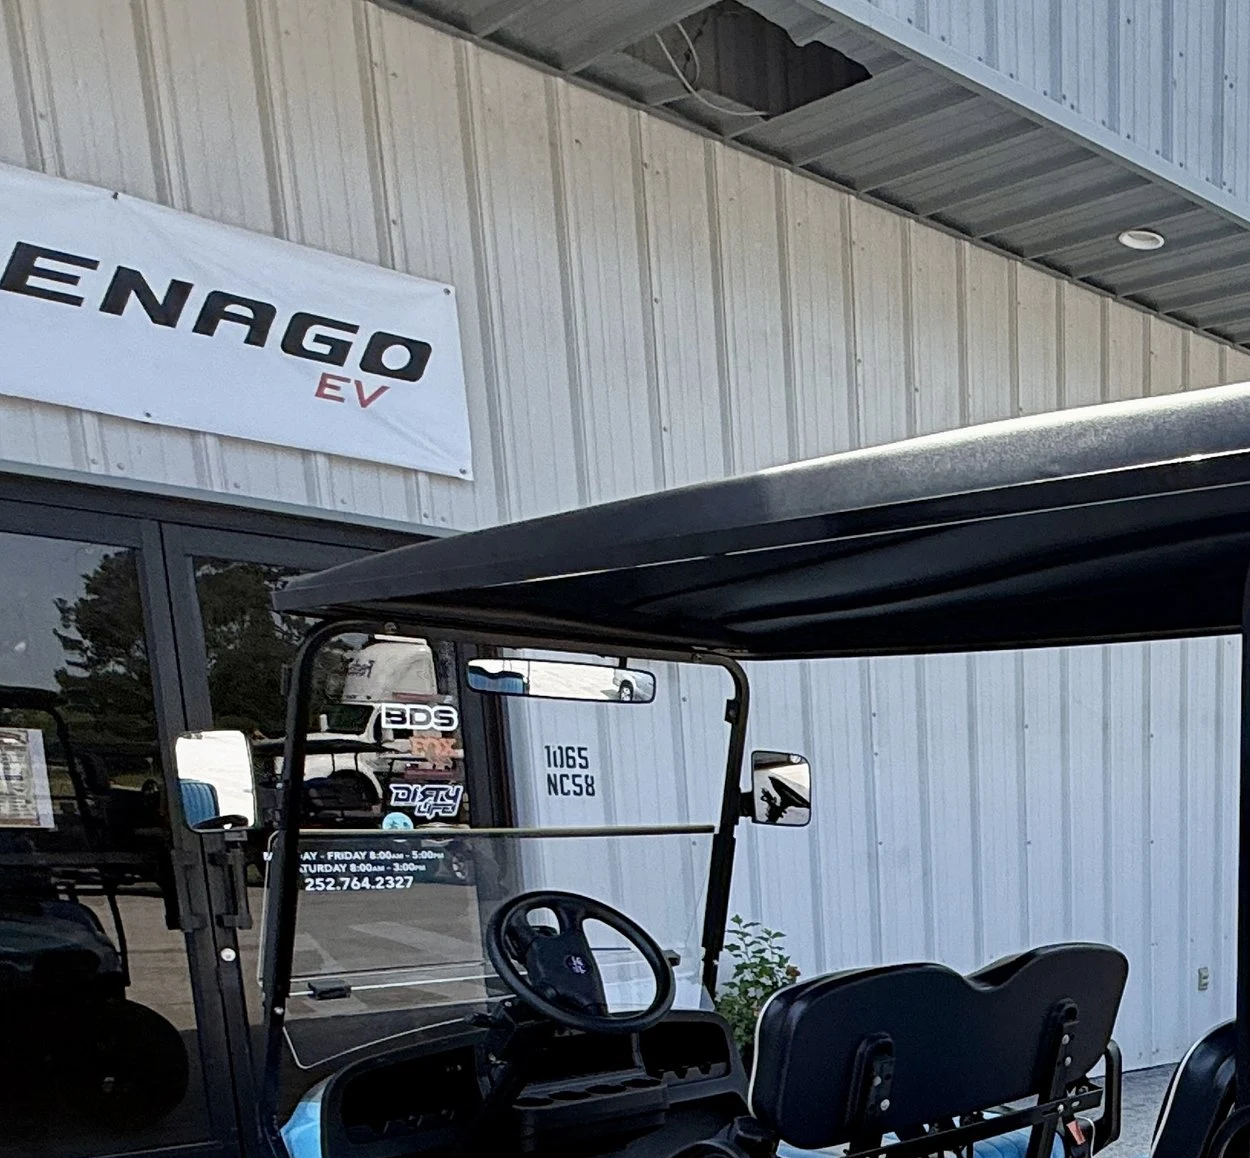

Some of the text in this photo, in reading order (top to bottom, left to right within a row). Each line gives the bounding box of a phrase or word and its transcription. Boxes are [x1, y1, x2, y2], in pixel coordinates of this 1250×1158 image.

[314, 371, 391, 409] EV
[382, 703, 458, 731] BDS
[547, 773, 596, 796] NC58
[327, 851, 367, 861] FRIDAY
[299, 863, 347, 873] TURDAY
[304, 876, 414, 891] 252.764.2327
